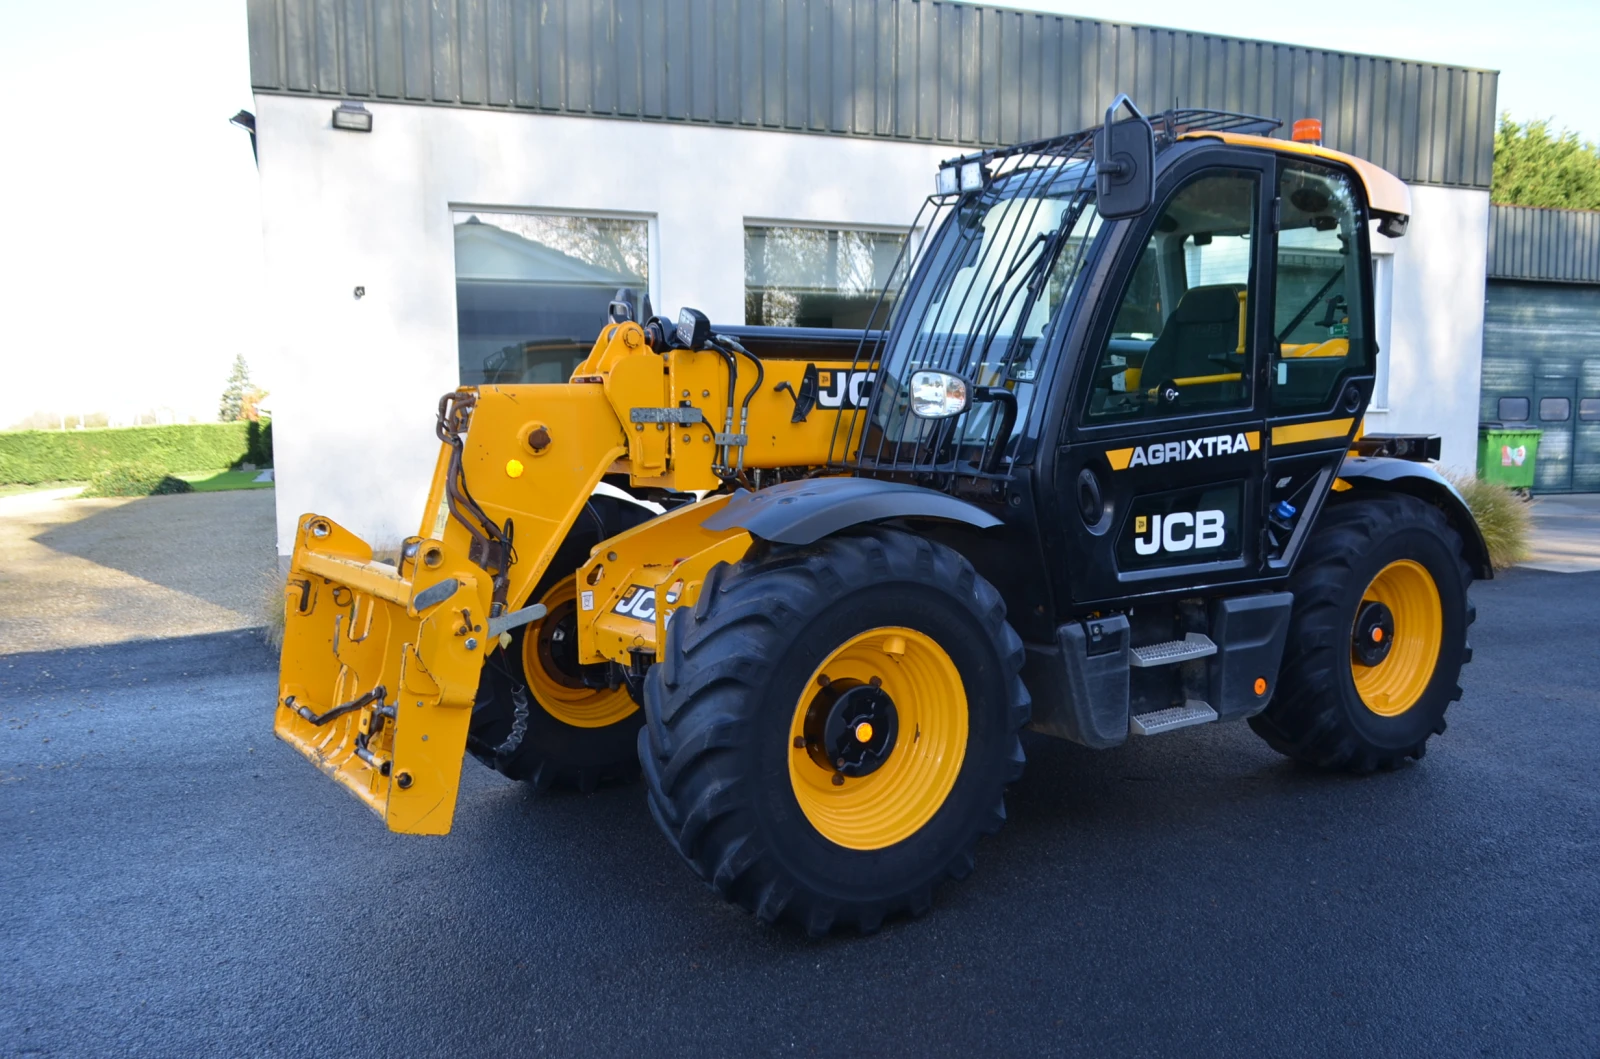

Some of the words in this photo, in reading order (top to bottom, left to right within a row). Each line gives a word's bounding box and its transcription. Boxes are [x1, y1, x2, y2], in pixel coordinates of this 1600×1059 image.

[819, 372, 876, 407] JC
[1129, 433, 1249, 468] AGRIXTRA
[1135, 509, 1225, 555] JCB
[615, 588, 656, 620] JC
